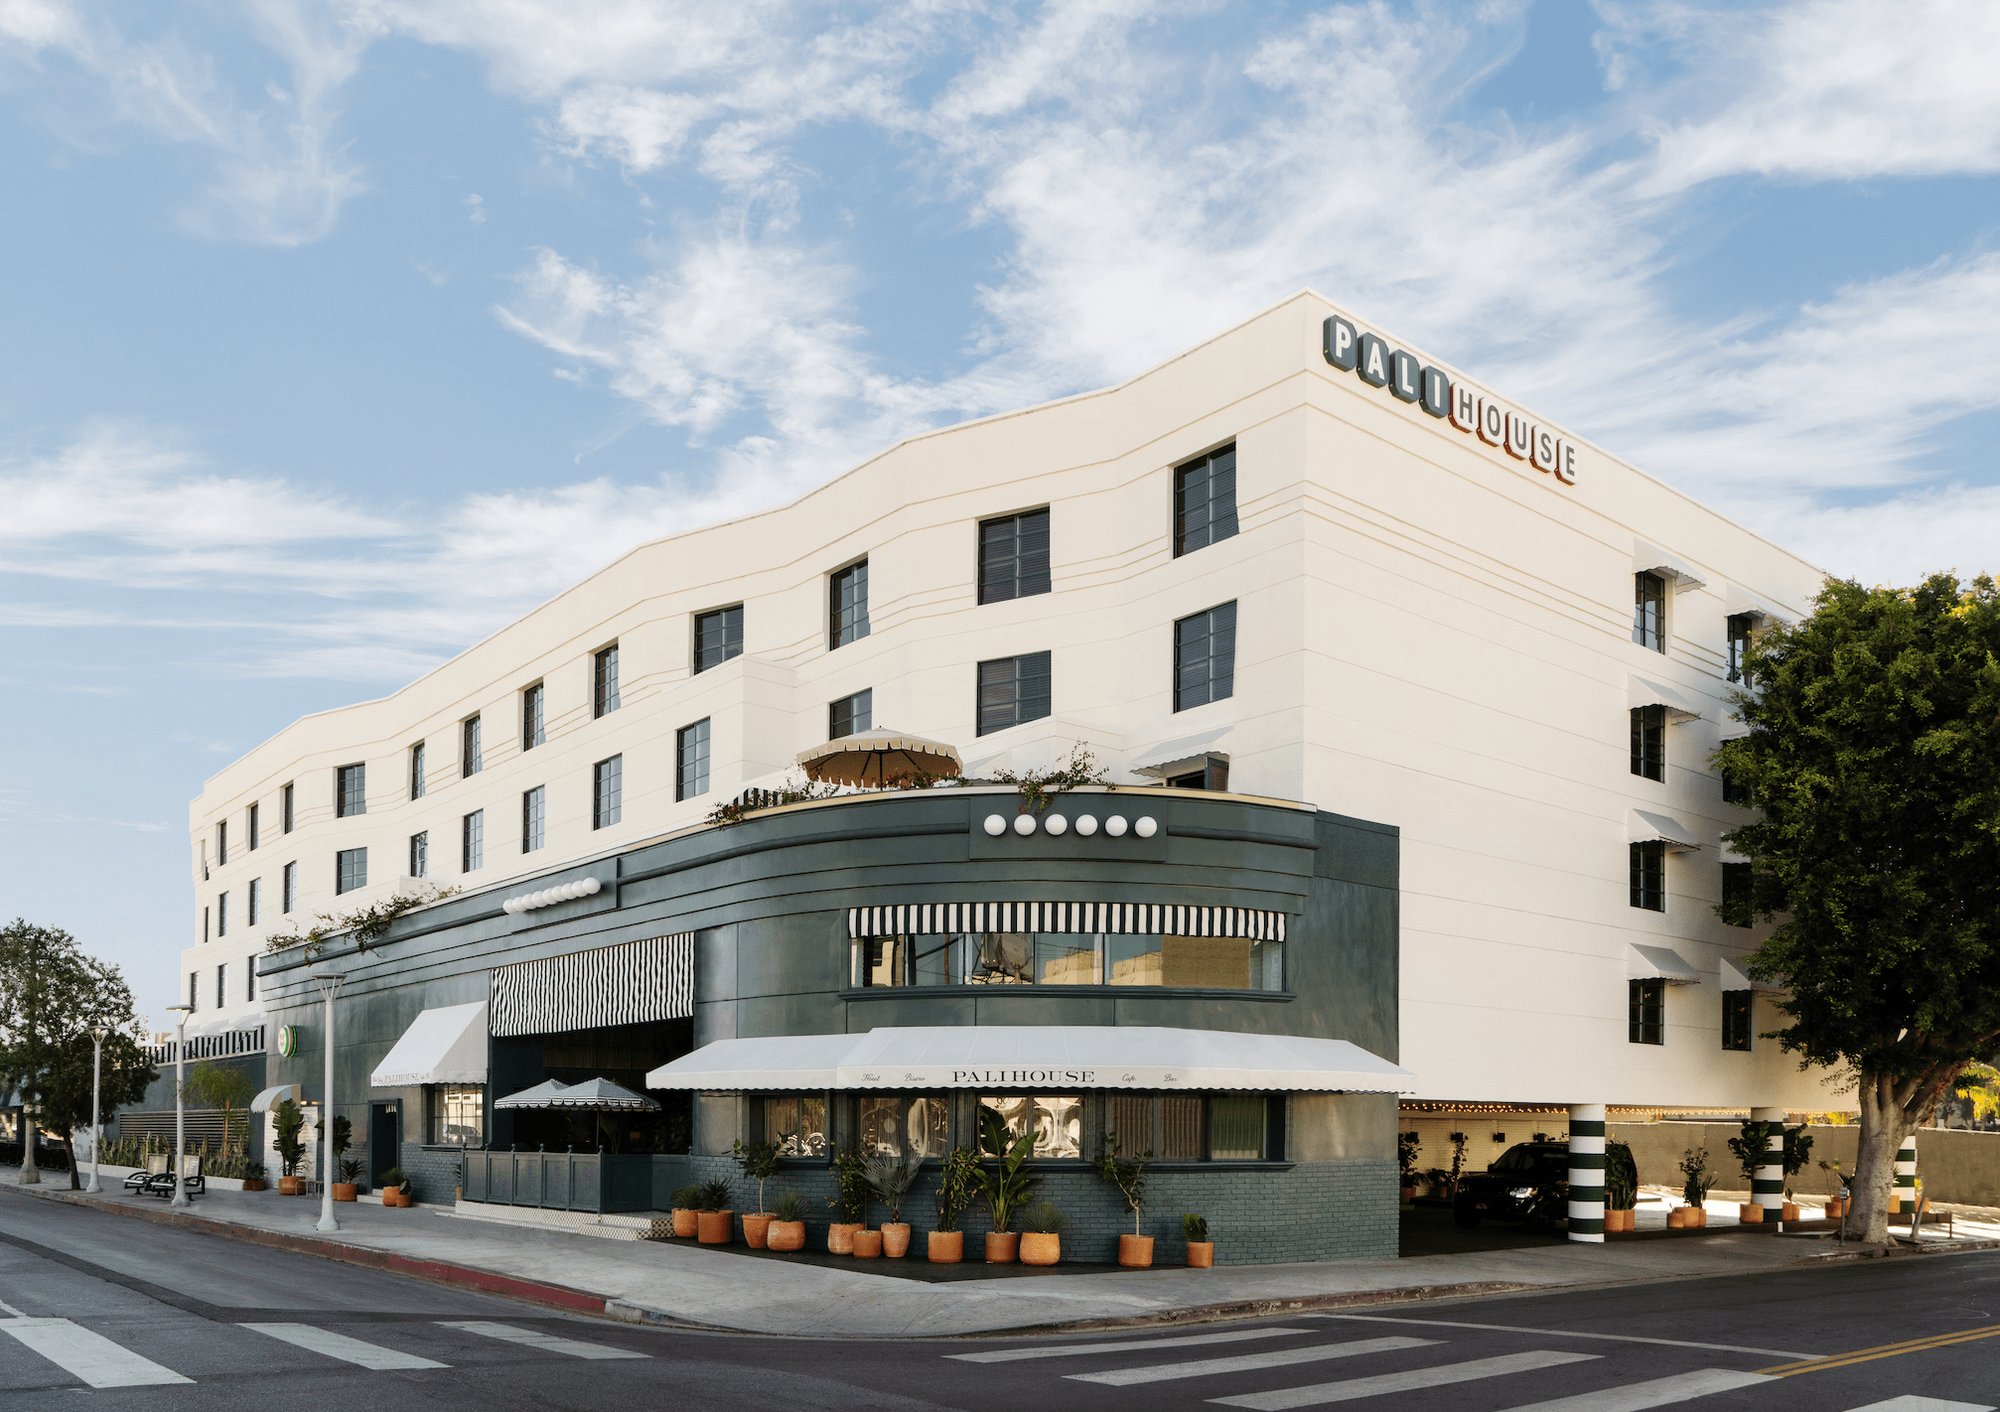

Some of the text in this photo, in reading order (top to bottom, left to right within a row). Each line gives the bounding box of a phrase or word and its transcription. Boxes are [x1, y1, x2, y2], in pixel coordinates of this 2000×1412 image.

[1335, 321, 1575, 477] PALIHOUSE
[384, 1072, 420, 1083] PALIHOUSE
[953, 1070, 1095, 1082] PALIHOUSE
